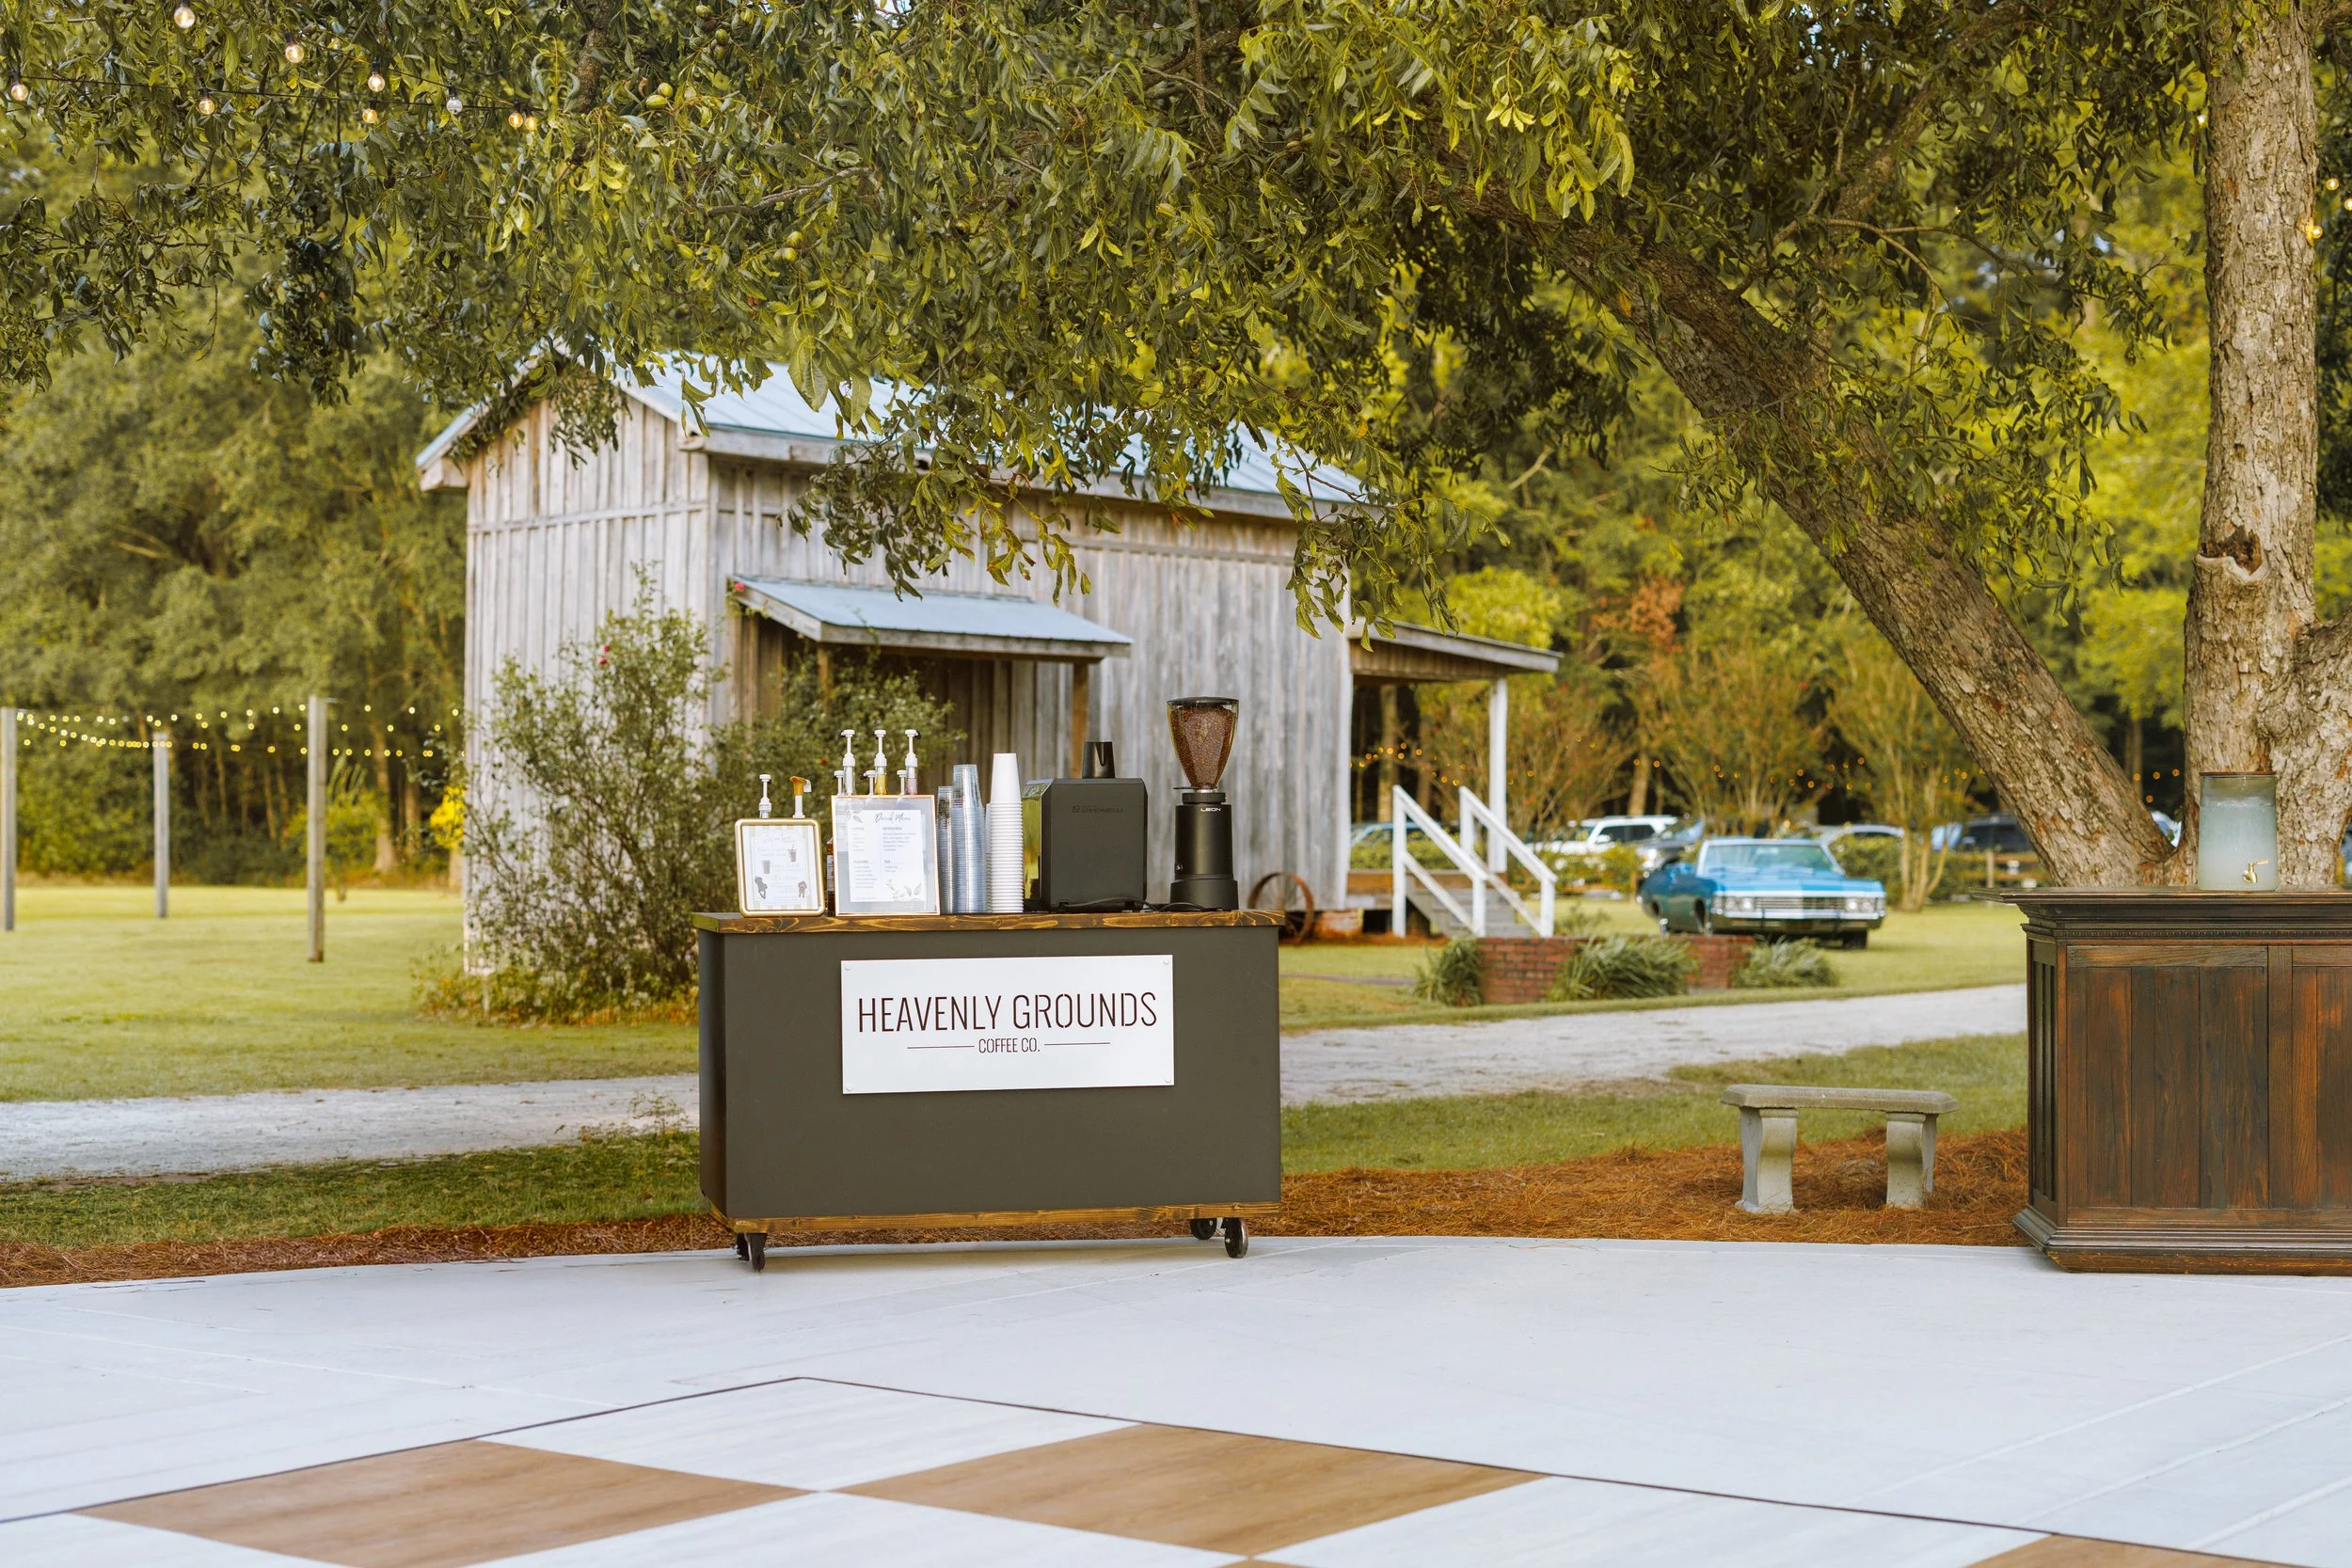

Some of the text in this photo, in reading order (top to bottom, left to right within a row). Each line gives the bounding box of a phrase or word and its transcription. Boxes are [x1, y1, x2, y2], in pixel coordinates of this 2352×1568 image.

[858, 992, 1157, 1033] HEAVENLY GROUNDS
[978, 1037, 1041, 1053] COFFEE CO.
